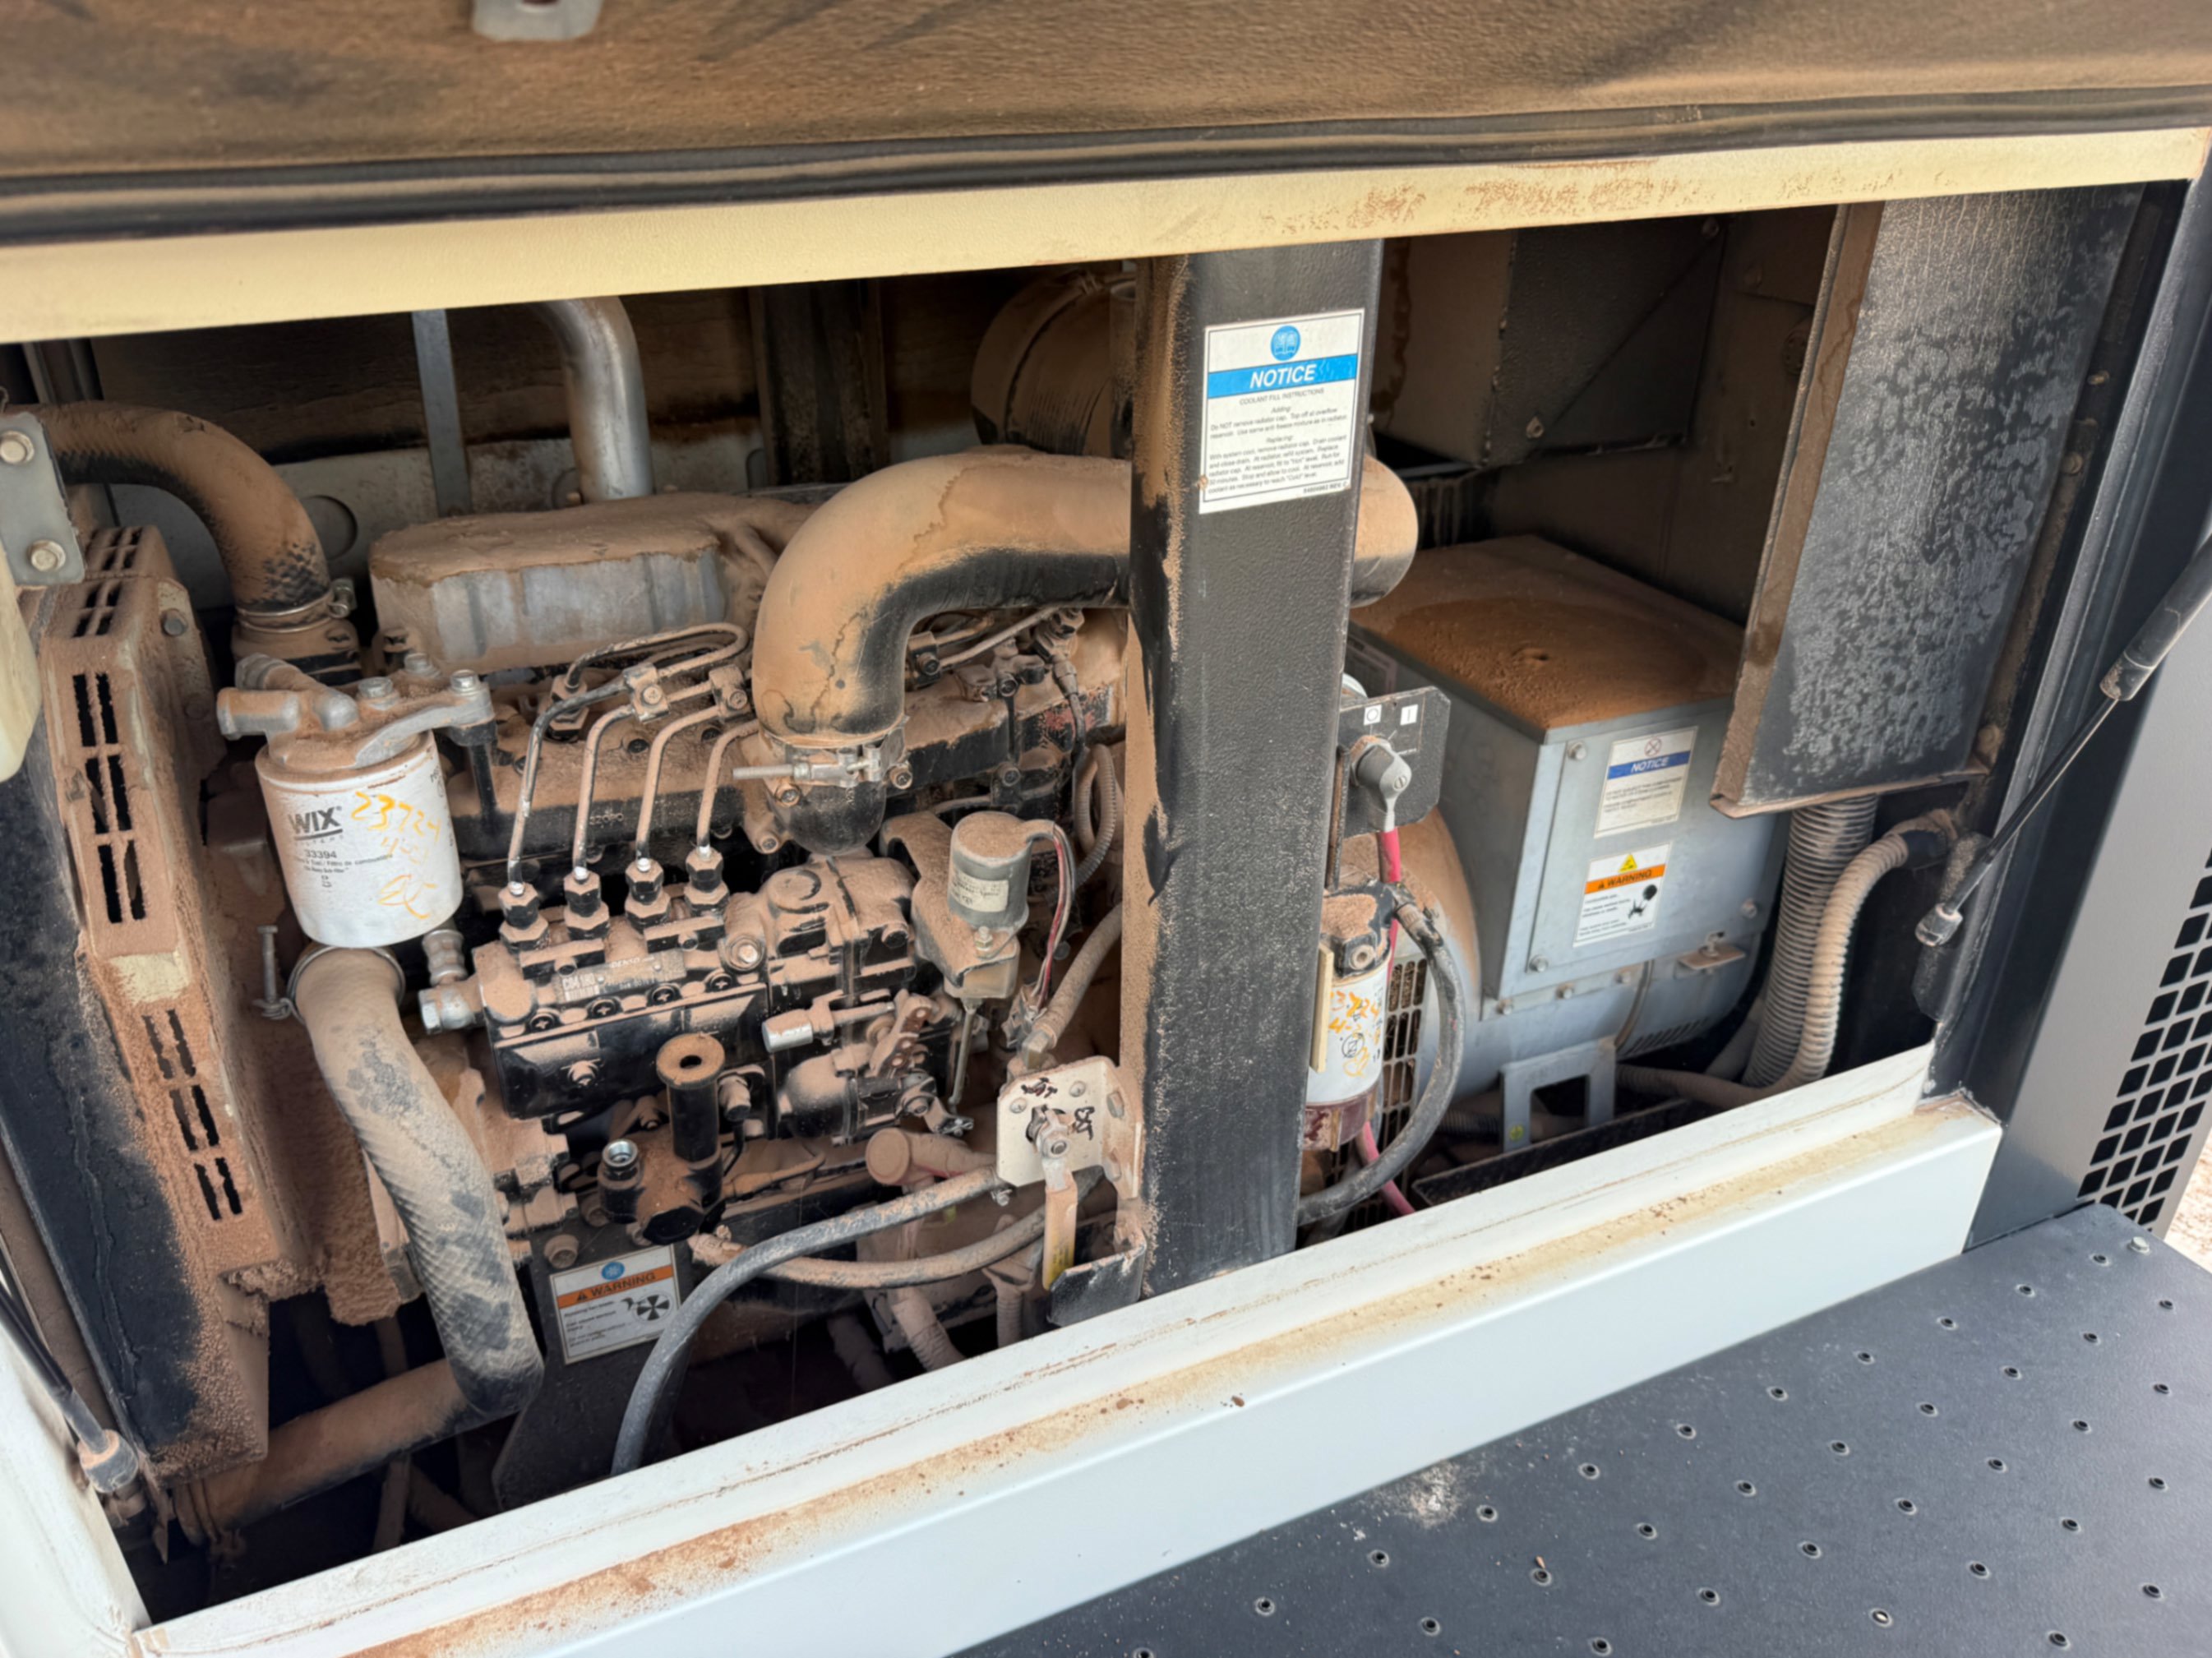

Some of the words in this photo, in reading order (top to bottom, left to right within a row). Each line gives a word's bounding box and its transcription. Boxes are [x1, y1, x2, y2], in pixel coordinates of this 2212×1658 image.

[1249, 363, 1317, 389] NOTICE
[1239, 395, 1268, 405] COOLANT
[1268, 393, 1281, 401] FILL
[1281, 386, 1324, 399] INSTRUCTIONS
[1631, 757, 1669, 773] NOTICE
[288, 806, 341, 834] WIX
[1608, 870, 1652, 886] WARNING
[590, 1272, 657, 1297] WARNING
